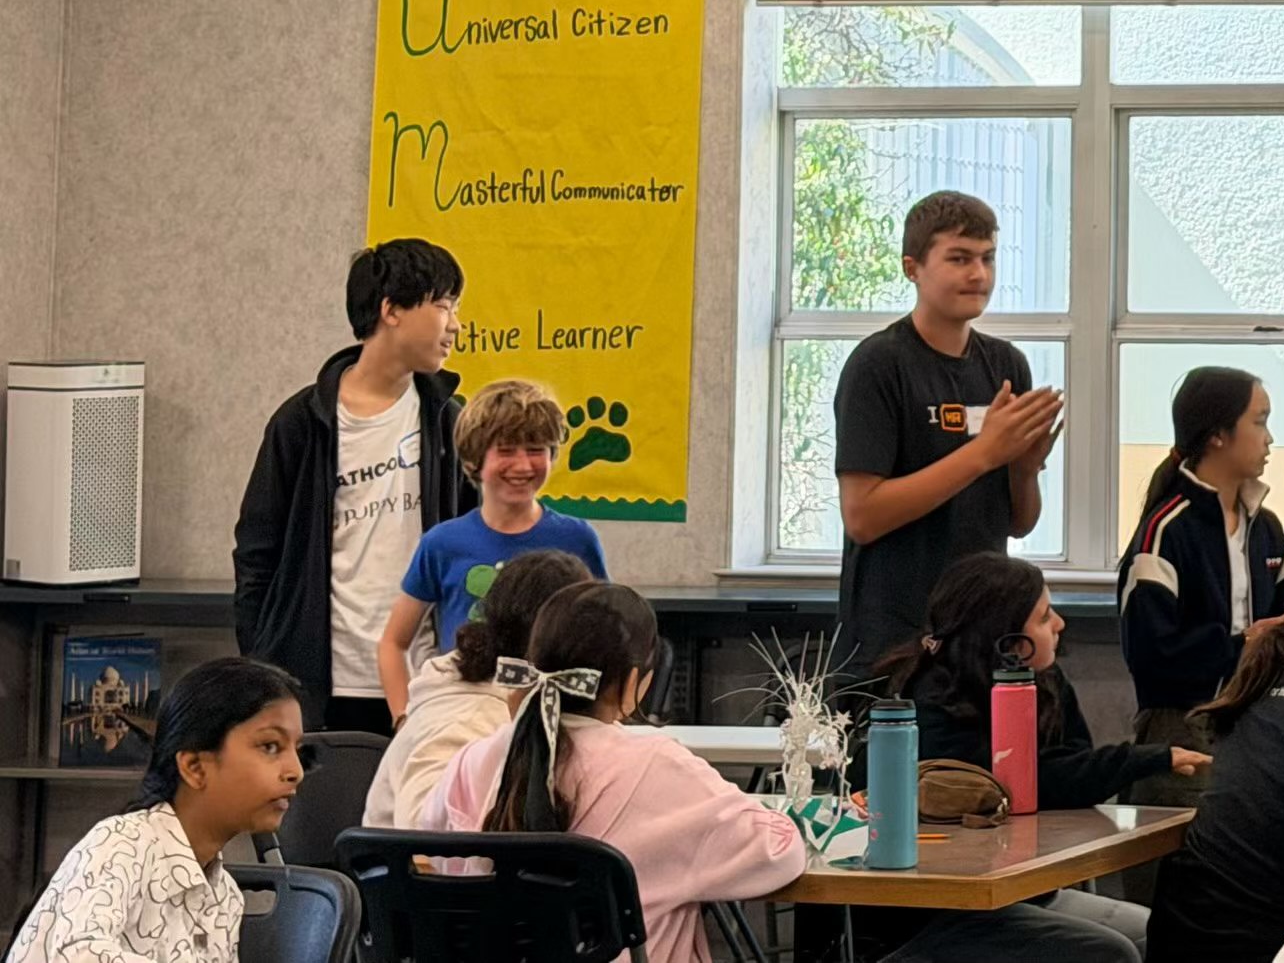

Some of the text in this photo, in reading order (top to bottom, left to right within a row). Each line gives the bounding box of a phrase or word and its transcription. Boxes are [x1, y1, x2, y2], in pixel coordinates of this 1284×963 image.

[572, 8, 669, 37] Citizen
[384, 111, 684, 211] Masterful Communicator
[454, 309, 644, 353] ctive Learner
